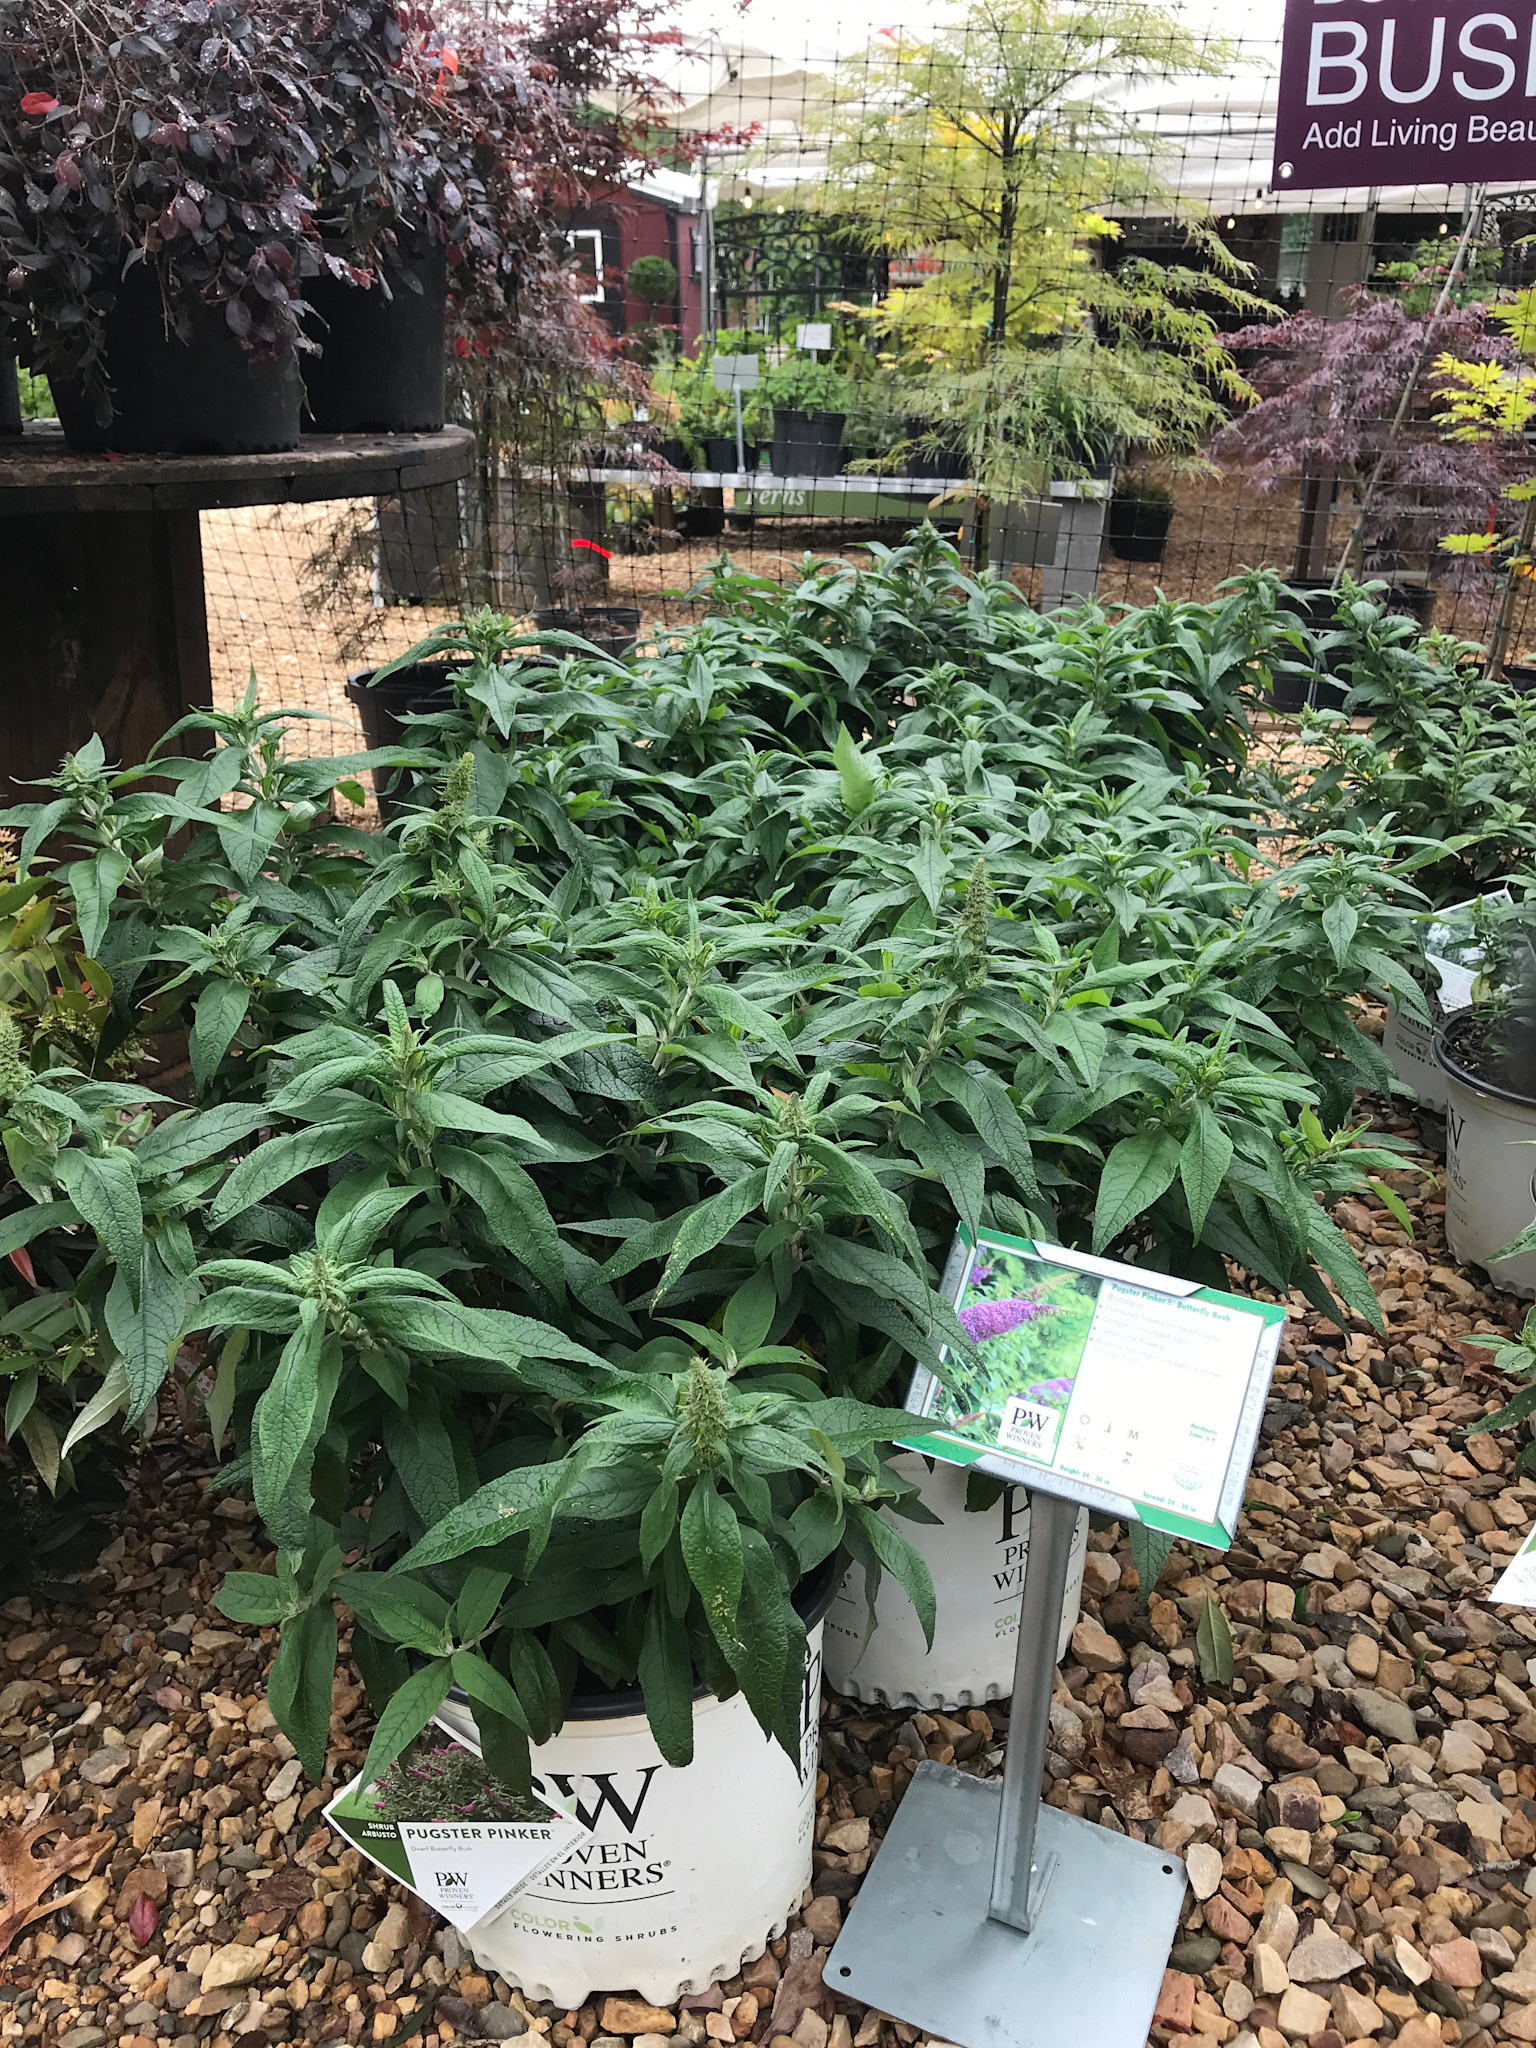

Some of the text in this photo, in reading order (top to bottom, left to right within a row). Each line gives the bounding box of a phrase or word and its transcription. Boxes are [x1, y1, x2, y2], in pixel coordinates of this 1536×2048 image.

[1306, 13, 1536, 106] BUS
[1302, 120, 1362, 150] Add
[1371, 118, 1458, 152] Living
[1177, 1300, 1211, 1318] Butterfly
[1212, 1310, 1231, 1322] Bush
[1010, 1426, 1041, 1441] PROVEN
[531, 1764, 663, 1834] W
[361, 1830, 397, 1839] ARBUSTO
[367, 1822, 395, 1831] SHRUB
[406, 1828, 482, 1840] PUGSTER
[430, 1845, 457, 1853] Butterfly
[494, 1831, 586, 1910] DETAILS INSIDE DETALLES EN EL INTERIOR
[511, 1908, 570, 1931] COLOR
[513, 1922, 678, 1943] FLOWERING SHRUBS
